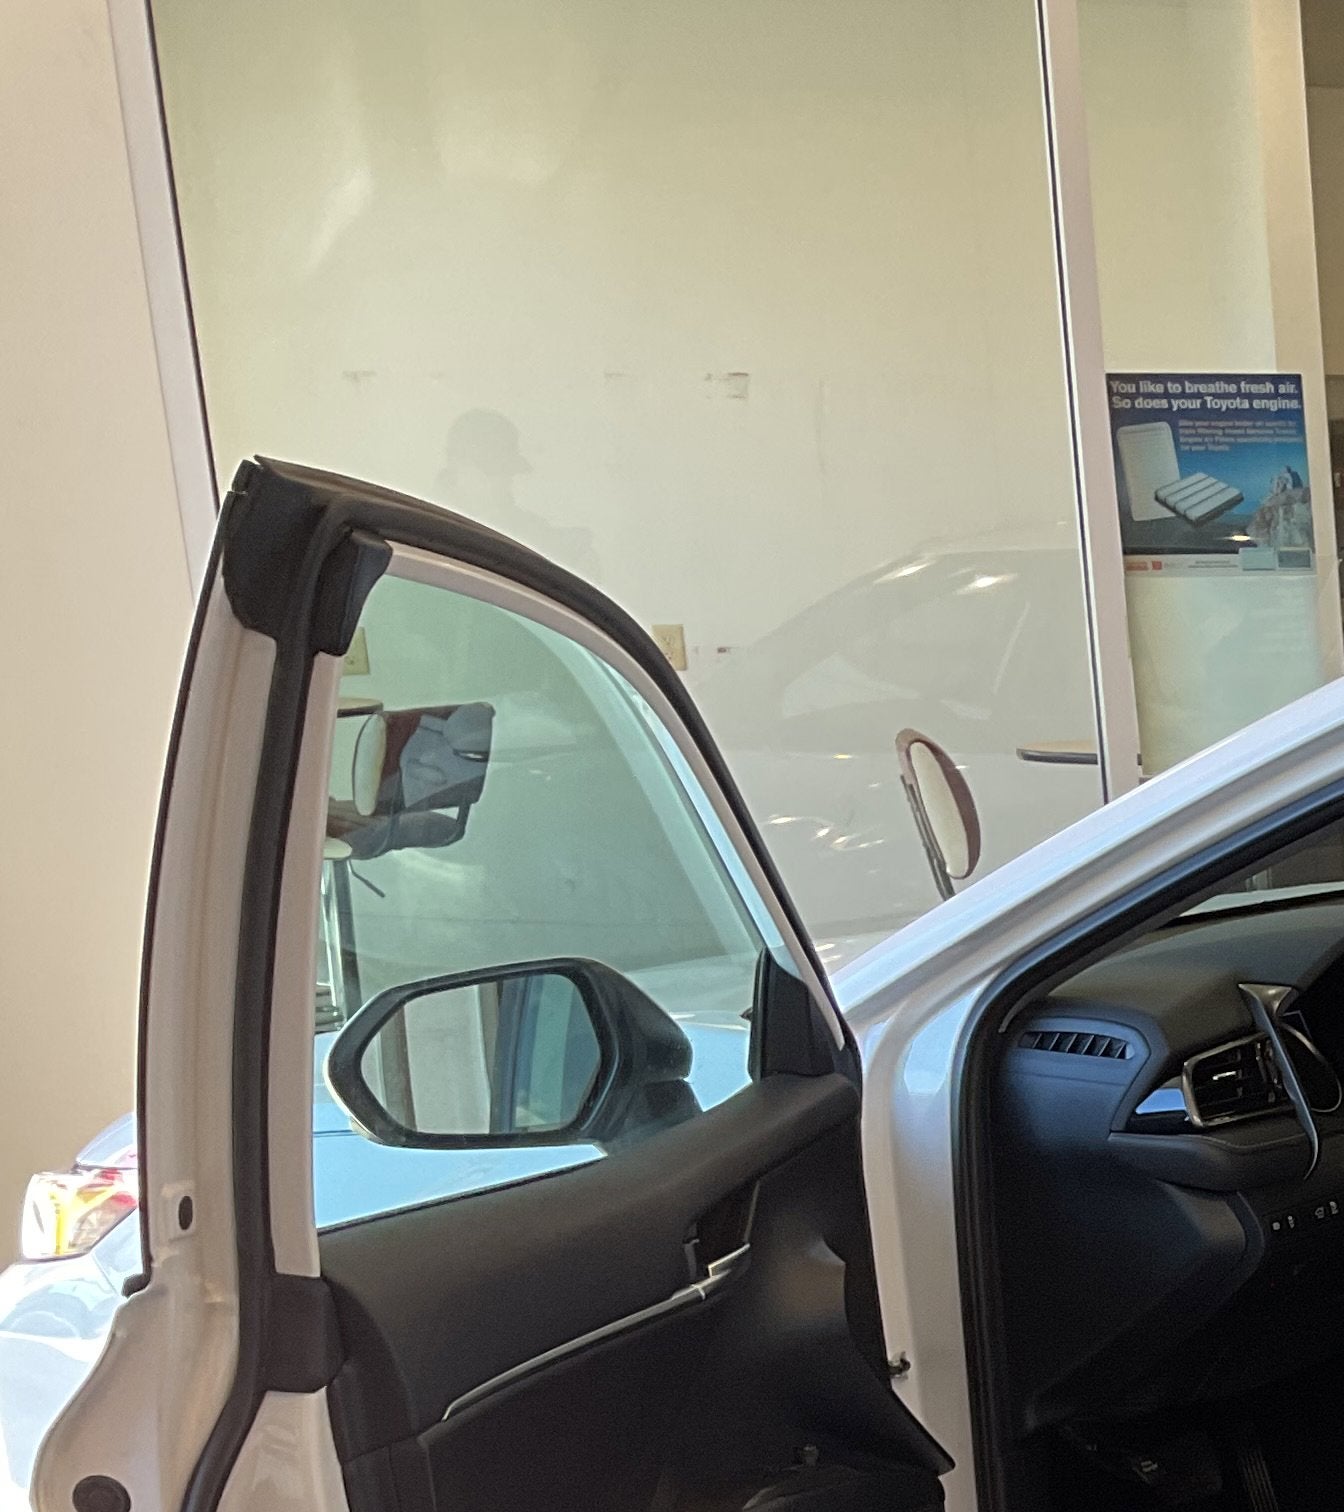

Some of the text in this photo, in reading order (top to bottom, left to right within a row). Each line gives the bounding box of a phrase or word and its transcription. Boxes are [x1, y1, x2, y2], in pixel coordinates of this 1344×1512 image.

[1109, 380, 1299, 394] You like to breathe fresh air.
[1112, 396, 1302, 412] So does your Toyota engine.
